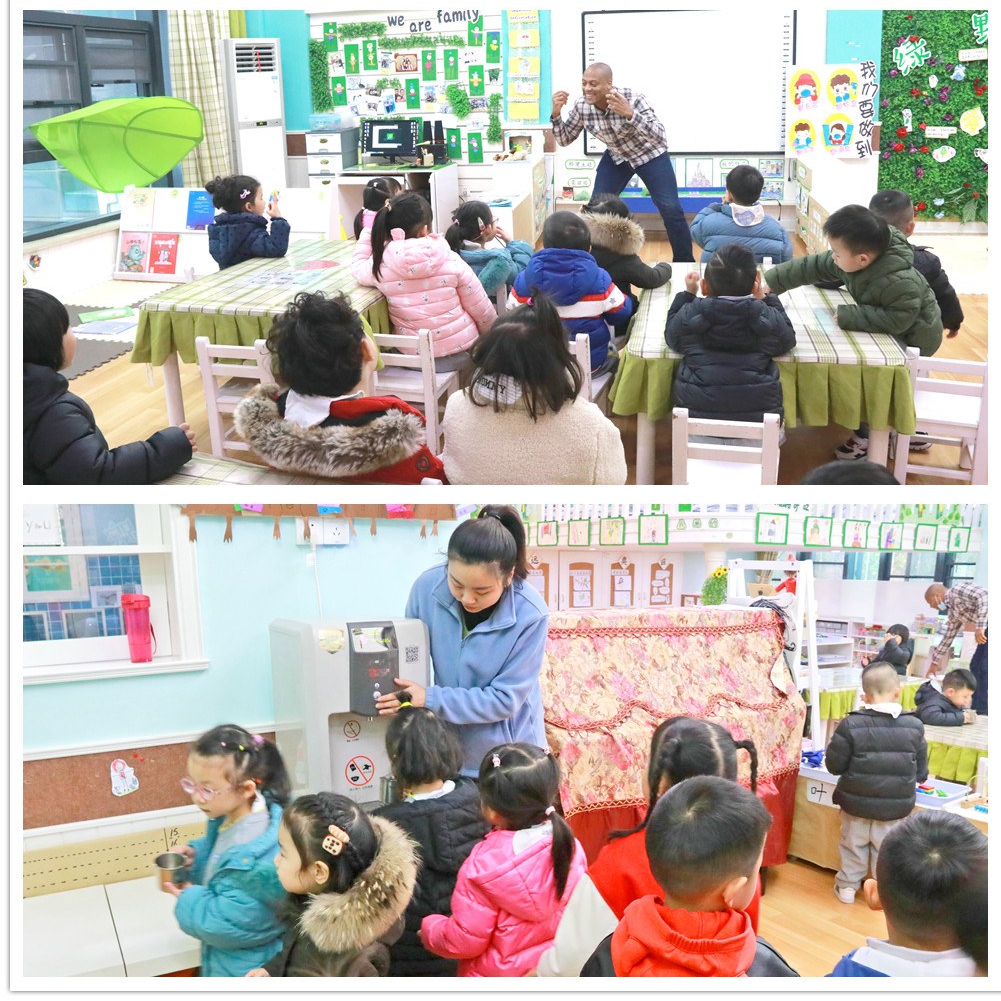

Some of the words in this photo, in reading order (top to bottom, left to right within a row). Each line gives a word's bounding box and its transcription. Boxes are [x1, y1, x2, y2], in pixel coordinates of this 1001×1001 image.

[387, 15, 405, 27] we
[437, 9, 479, 23] family
[409, 20, 432, 33] are
[855, 61, 879, 159] 我们要做到
